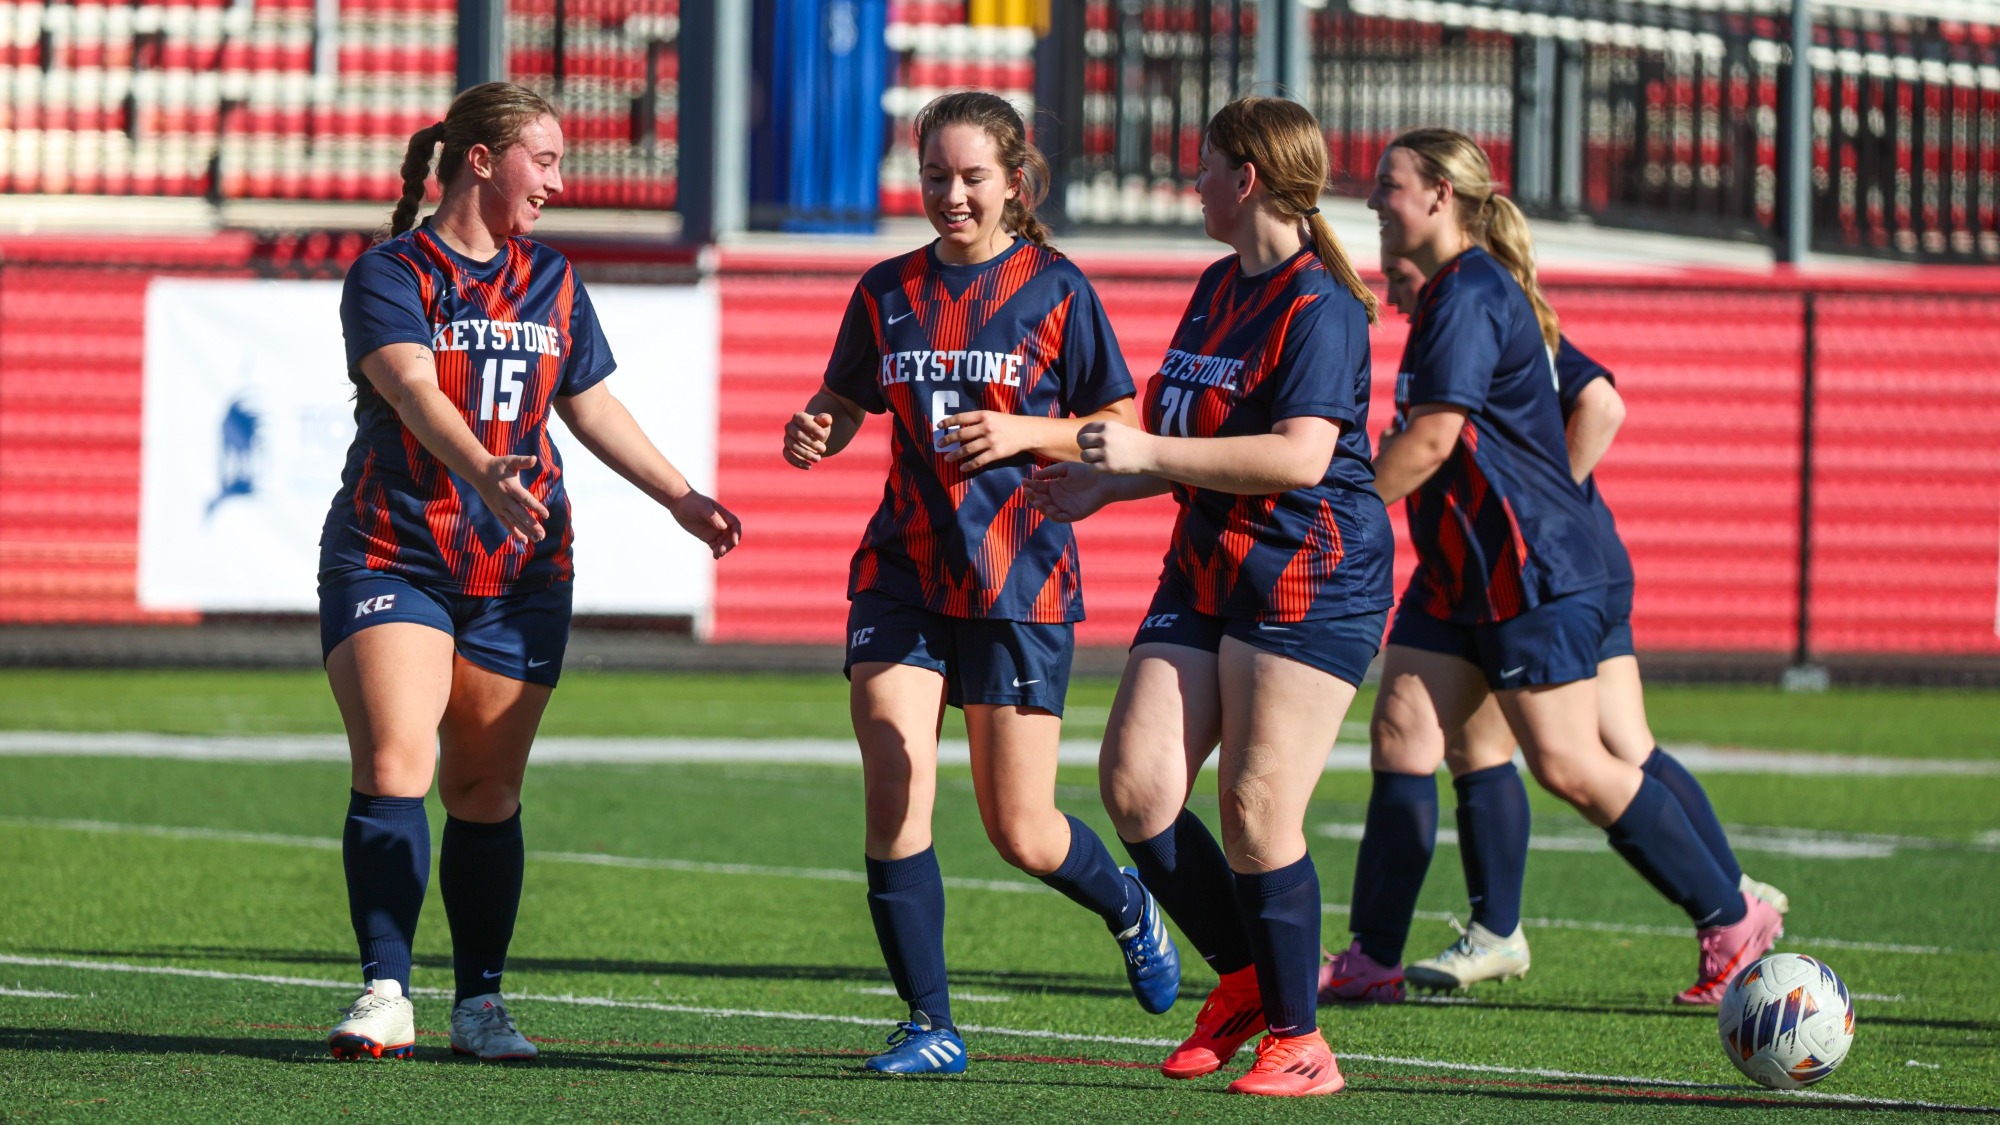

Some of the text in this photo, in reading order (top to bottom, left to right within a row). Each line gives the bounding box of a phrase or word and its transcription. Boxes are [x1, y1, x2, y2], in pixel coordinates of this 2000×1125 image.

[432, 319, 560, 357] KEYSTONE
[882, 350, 1022, 387] KEYSTONE
[480, 358, 527, 421] 15
[932, 390, 961, 453] 6
[1160, 386, 1194, 438] 21
[354, 593, 398, 619] KC
[1141, 613, 1179, 630] KC
[850, 626, 876, 649] KC
